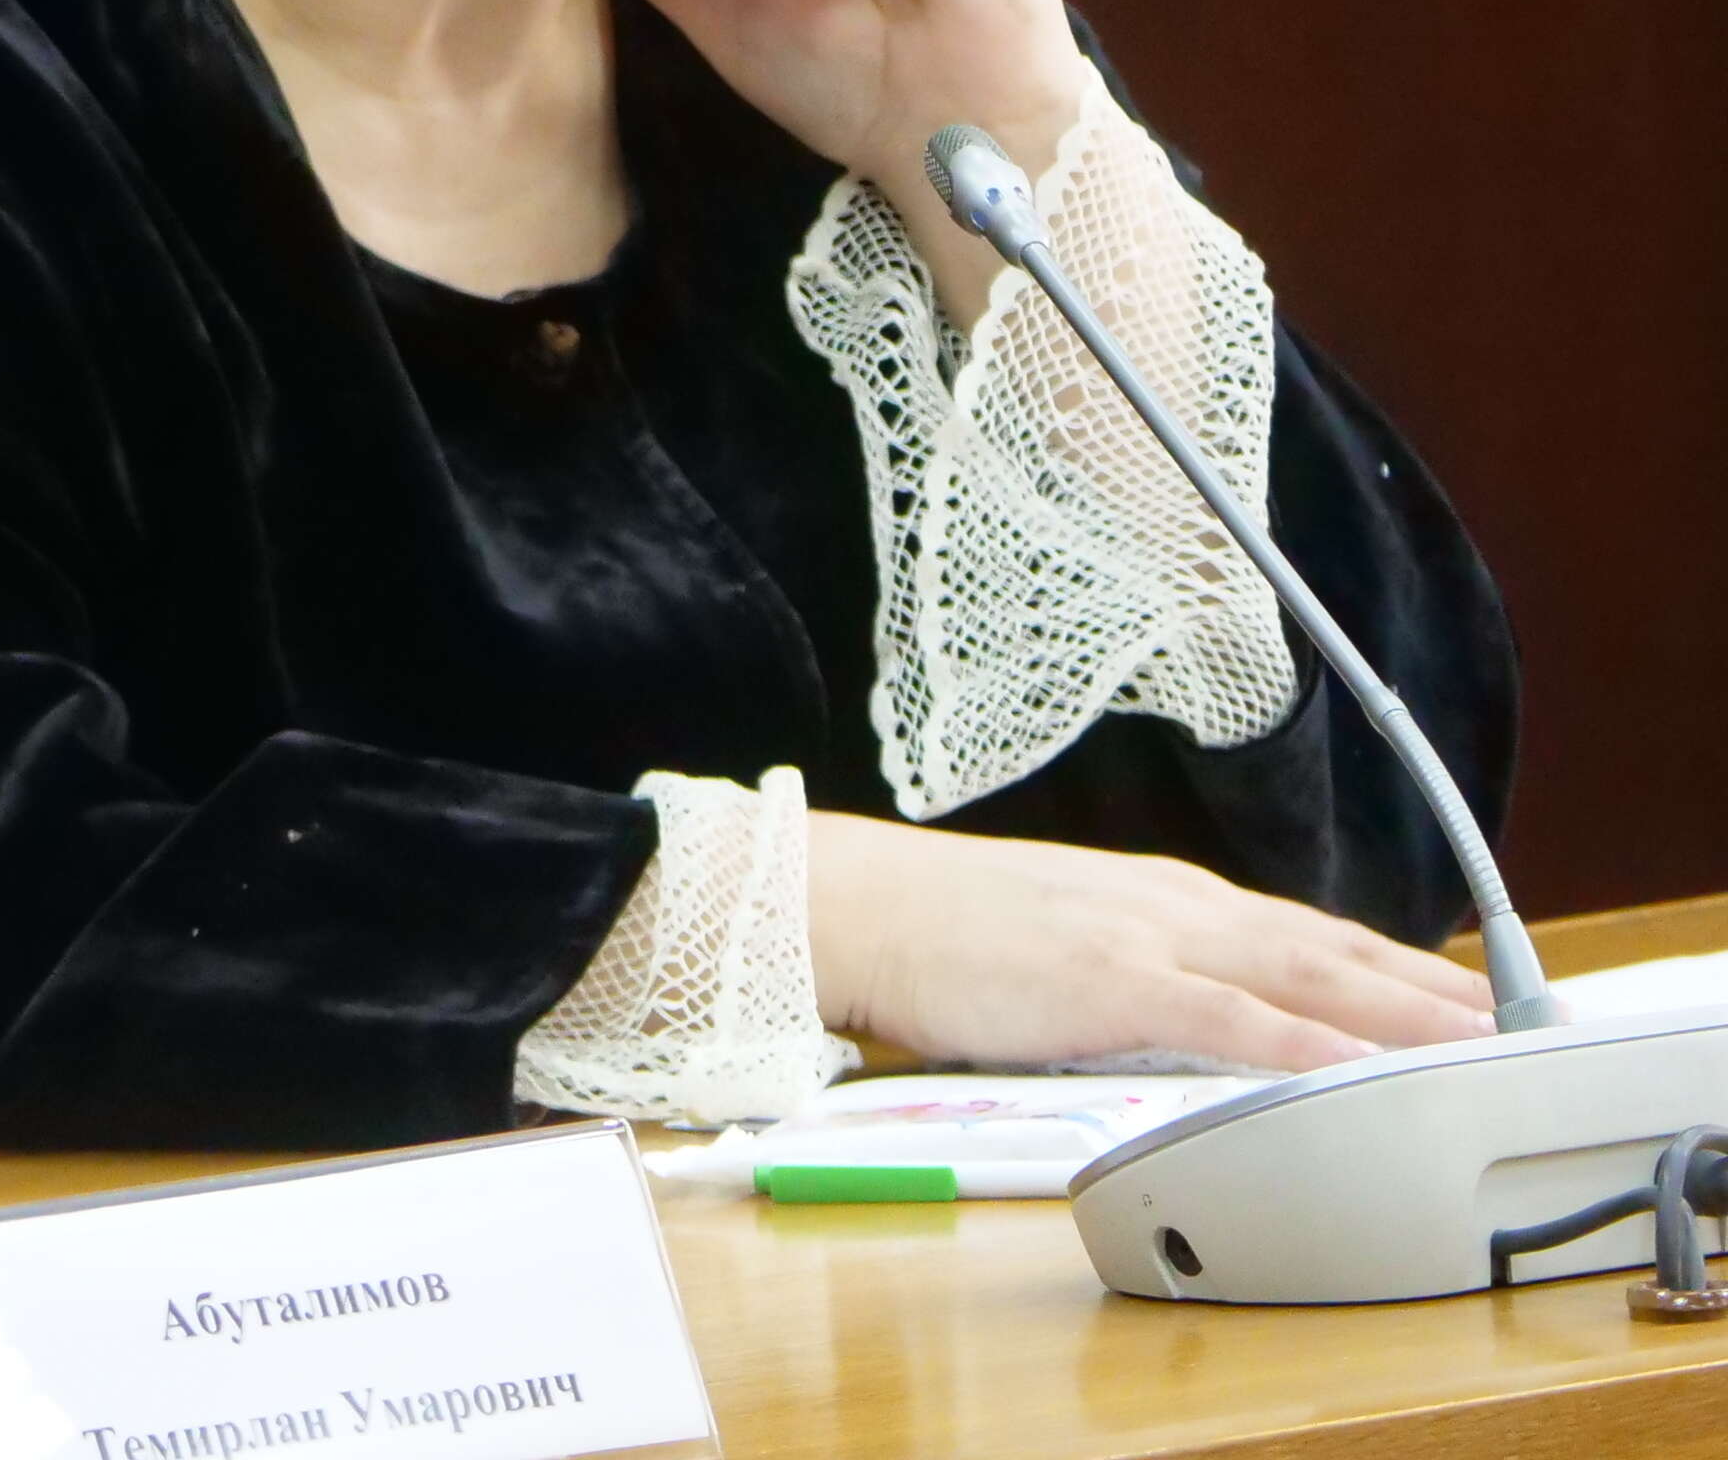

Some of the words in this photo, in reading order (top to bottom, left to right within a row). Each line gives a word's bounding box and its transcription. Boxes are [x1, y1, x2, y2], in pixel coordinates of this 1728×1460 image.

[162, 1271, 450, 1344] Абуталимов
[81, 1407, 332, 1460] Темирлан
[340, 1371, 584, 1434] Умарович
